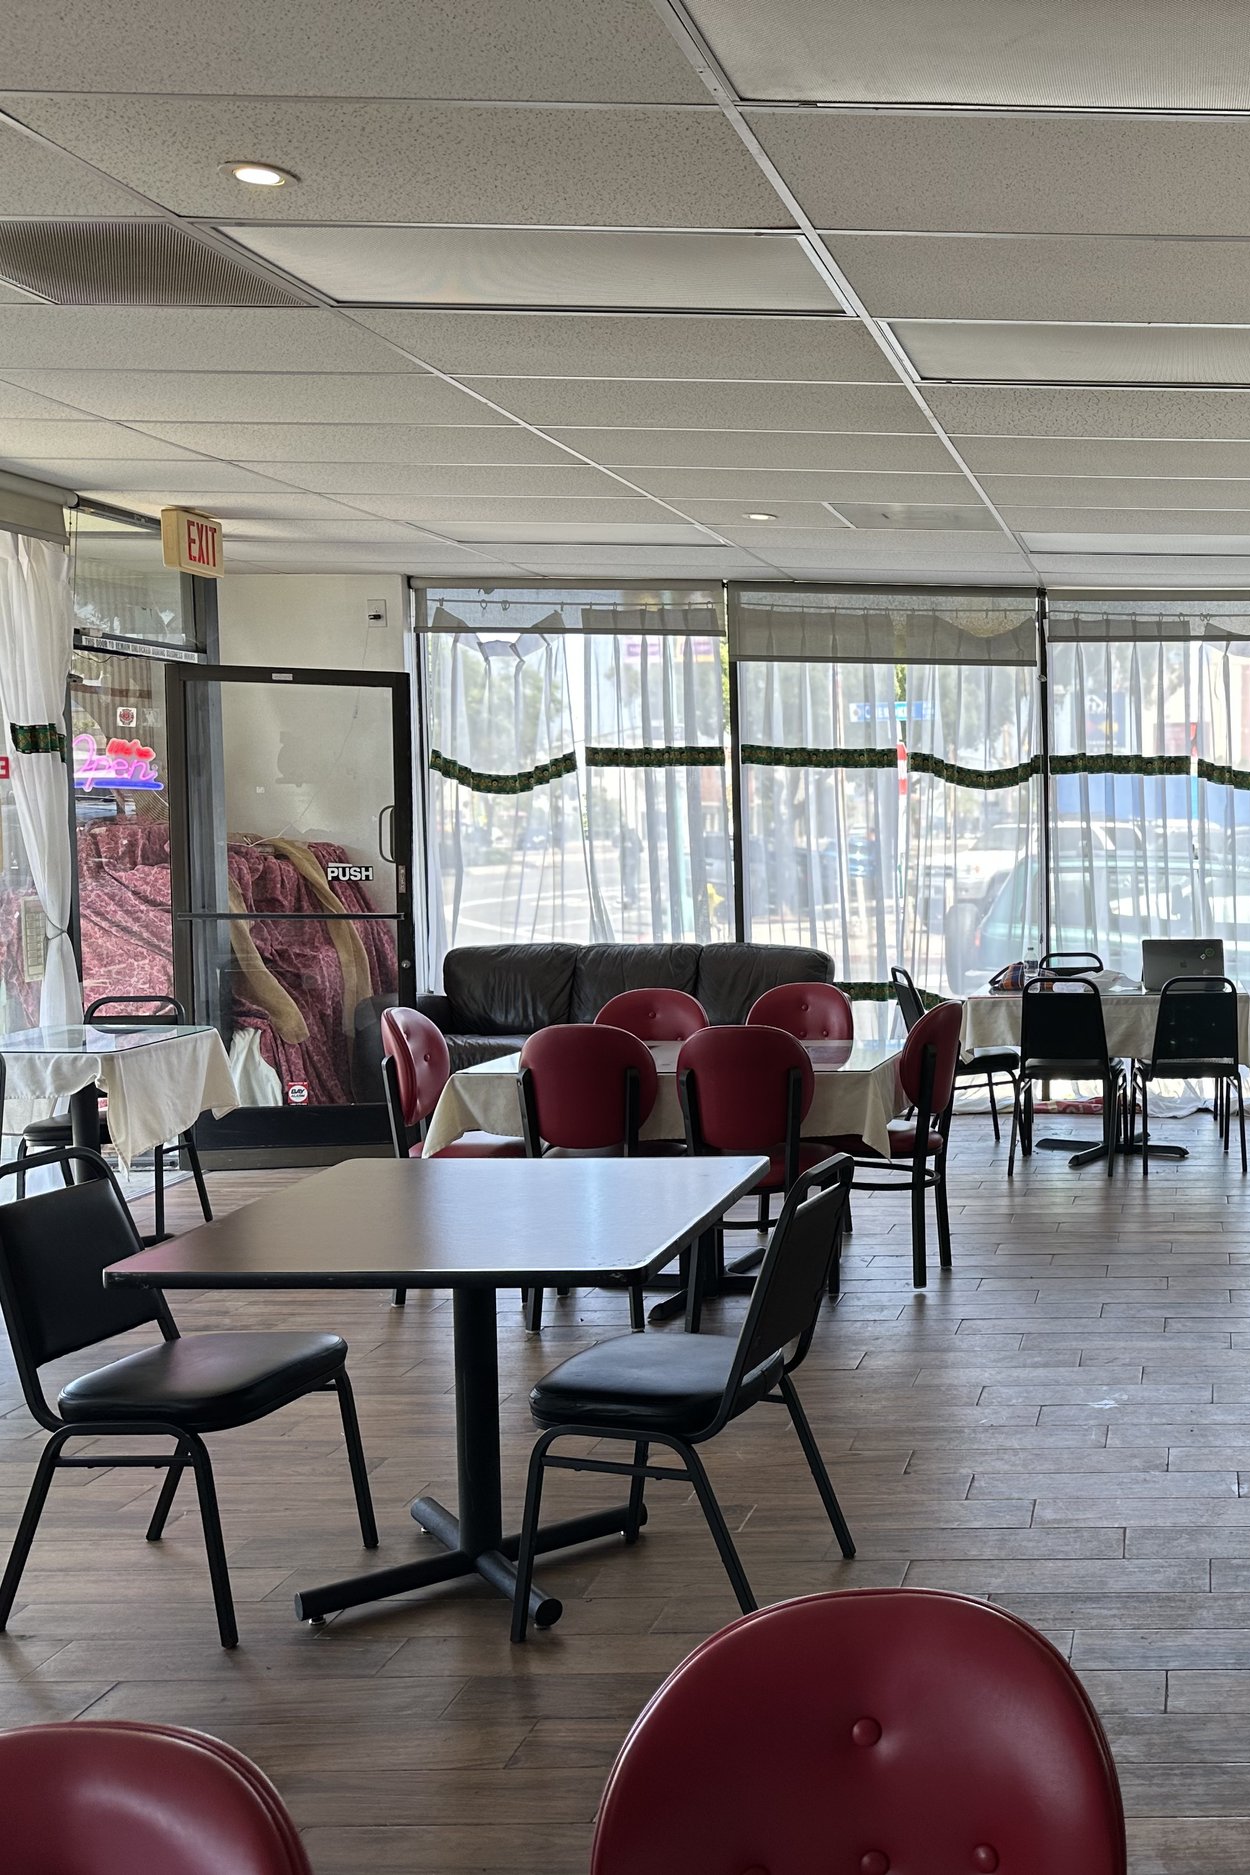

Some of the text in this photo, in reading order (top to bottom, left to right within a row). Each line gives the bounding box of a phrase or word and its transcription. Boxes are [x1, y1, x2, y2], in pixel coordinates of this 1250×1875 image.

[187, 519, 217, 567] EXIT
[84, 637, 95, 647] THIS
[96, 638, 108, 649] DOOR
[108, 640, 115, 649] TO
[327, 867, 373, 881] PUSH
